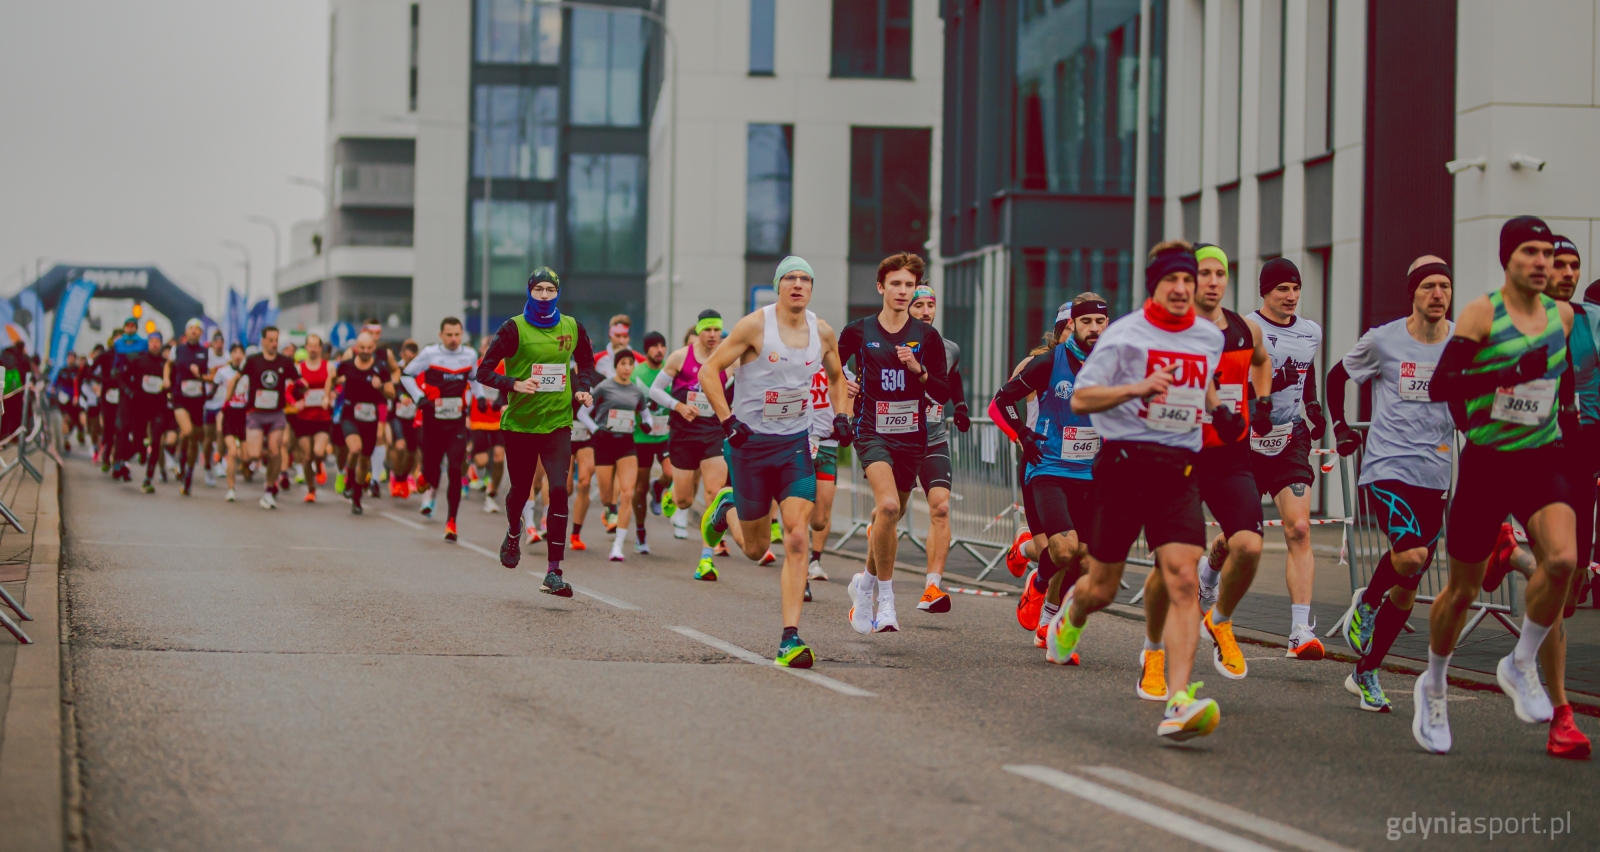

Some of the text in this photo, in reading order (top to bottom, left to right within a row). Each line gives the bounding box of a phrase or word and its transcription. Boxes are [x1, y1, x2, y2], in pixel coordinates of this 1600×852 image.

[540, 376, 556, 385] 352
[881, 368, 906, 391] 534
[781, 405, 788, 414] 5
[1503, 397, 1540, 413] 3855
[1158, 407, 1191, 422] 3462
[885, 415, 908, 425] 1769
[1072, 442, 1093, 451] 646
[1258, 438, 1283, 448] 1036
